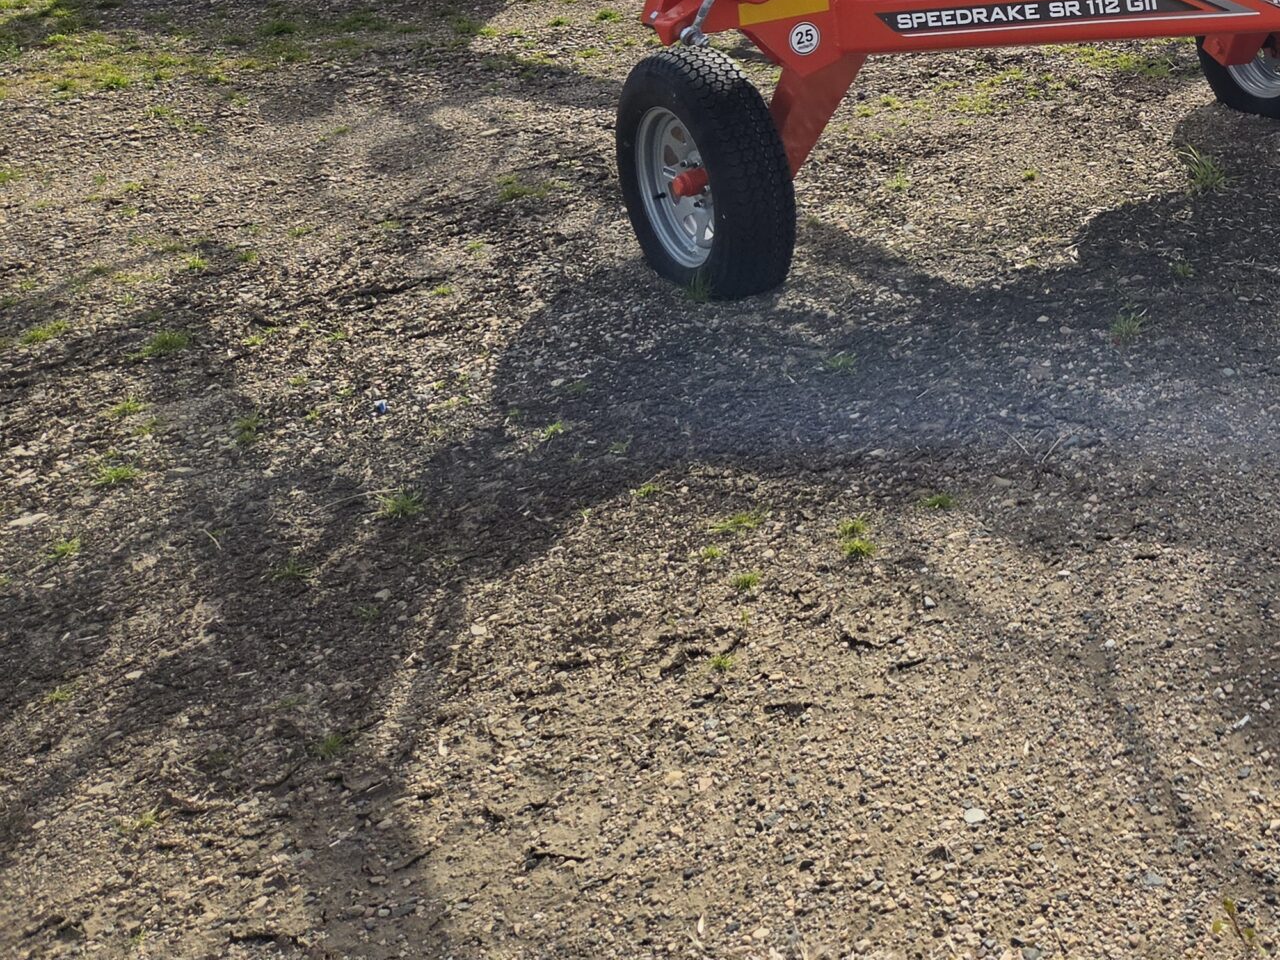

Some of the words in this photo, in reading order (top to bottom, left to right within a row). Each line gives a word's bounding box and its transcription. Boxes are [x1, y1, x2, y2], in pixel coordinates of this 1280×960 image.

[896, 3, 1040, 29] SPEEDRAKE
[1049, 0, 1082, 18] SR
[795, 29, 814, 45] 25
